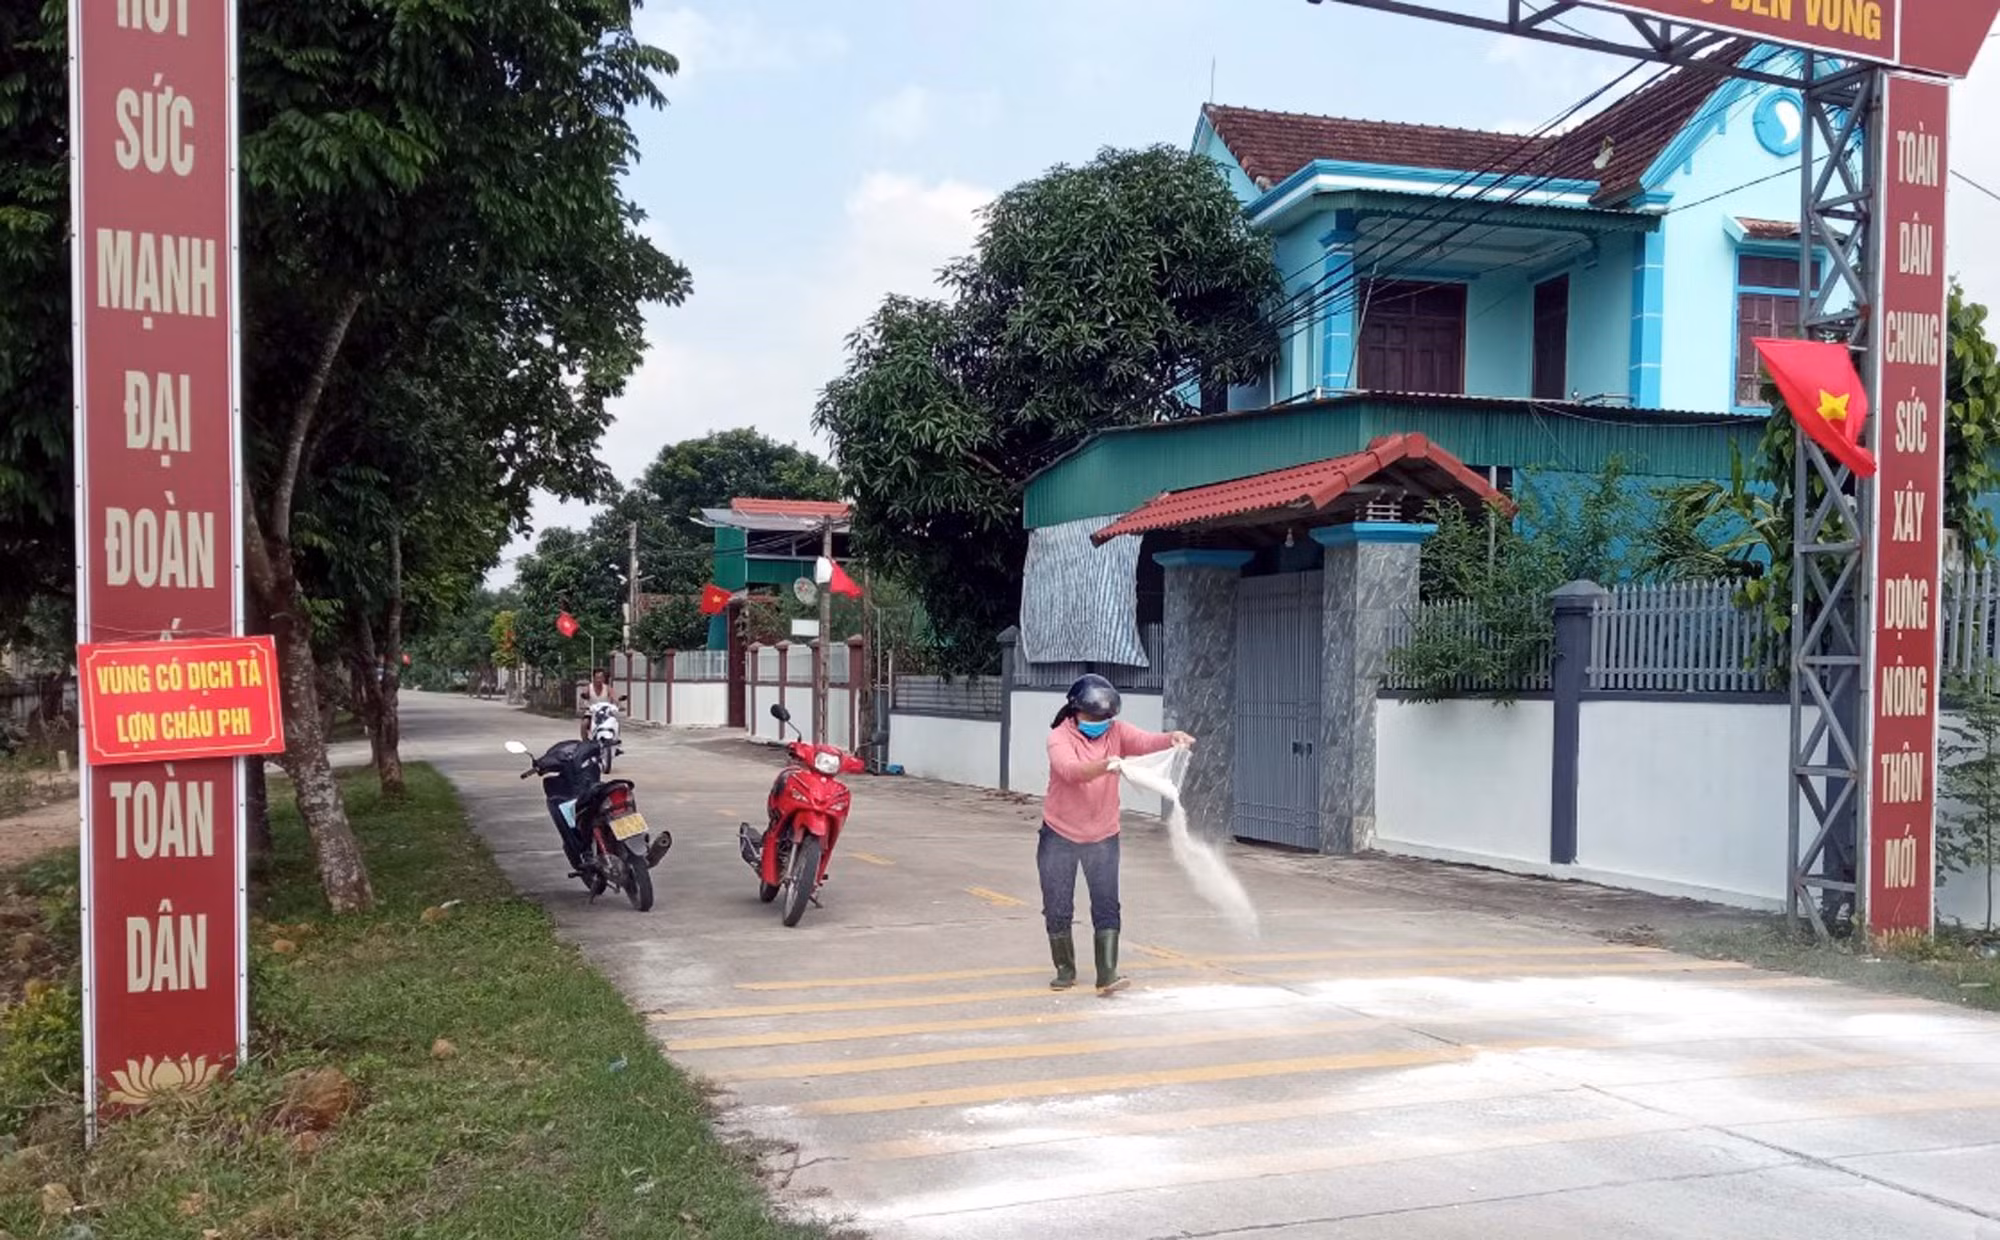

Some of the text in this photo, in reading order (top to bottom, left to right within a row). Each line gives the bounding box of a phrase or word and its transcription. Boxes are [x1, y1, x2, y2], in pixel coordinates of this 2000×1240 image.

[115, 72, 194, 176] SỨC
[1897, 121, 1939, 187] TOÀN
[1899, 211, 1933, 276] DÂN
[97, 228, 216, 330] MẠNH
[1885, 310, 1939, 366] CHUNG
[124, 370, 191, 468] ĐẠI
[1895, 386, 1927, 453] SỨC
[105, 490, 215, 588] ĐOÀN
[1892, 480, 1925, 542] XÂY
[1884, 573, 1928, 640] DỰNG
[96, 660, 152, 695] VÙNG
[187, 659, 233, 697] DỊCH
[236, 649, 262, 687] TẢ
[1881, 655, 1927, 717] NÔNG
[116, 703, 252, 749] LỢN CHÂU PHI
[1881, 741, 1924, 804] THÔN
[110, 763, 214, 859] TOÀN
[1884, 824, 1917, 889] MỚI
[126, 898, 207, 993] DÂN
